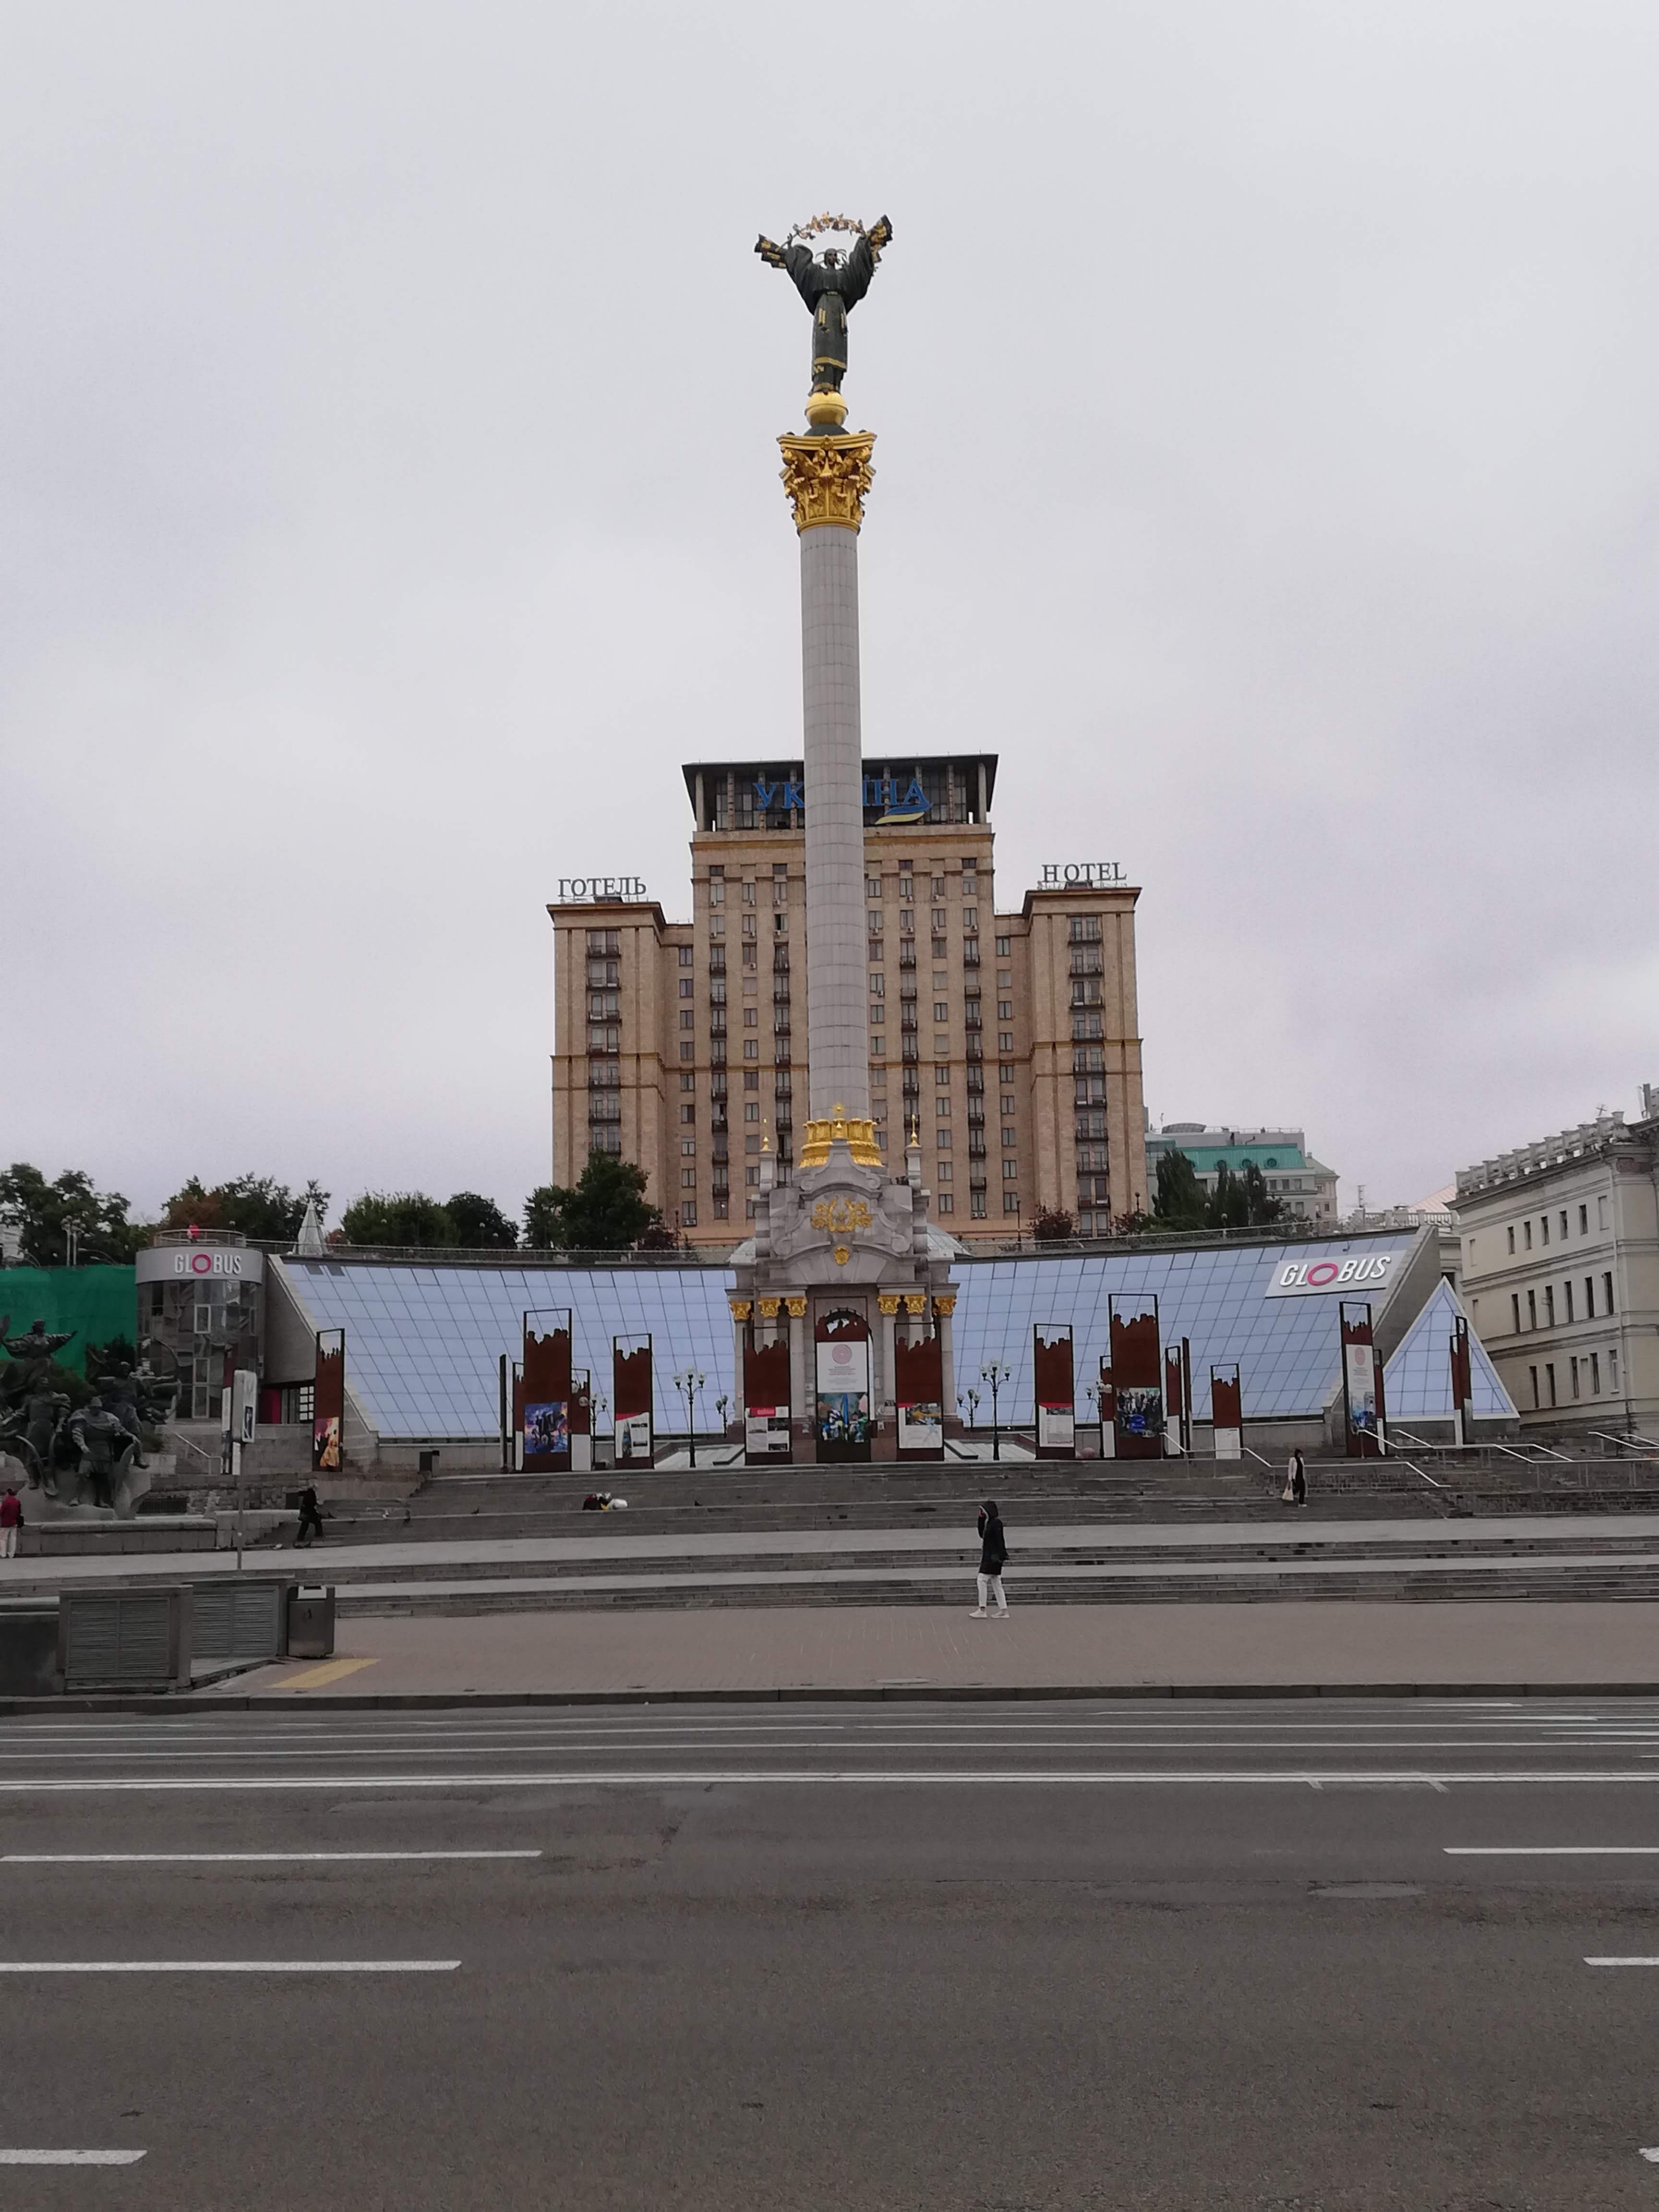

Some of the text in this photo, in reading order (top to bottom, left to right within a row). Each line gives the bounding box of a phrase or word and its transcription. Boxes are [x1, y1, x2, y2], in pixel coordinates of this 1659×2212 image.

[753, 774, 929, 810] УКЇНА
[1041, 862, 1127, 883] HOTEL
[557, 877, 646, 897] ГОТЕЛЬ
[175, 1253, 242, 1274] GLOBUS
[1279, 1256, 1391, 1287] GLOBUS
